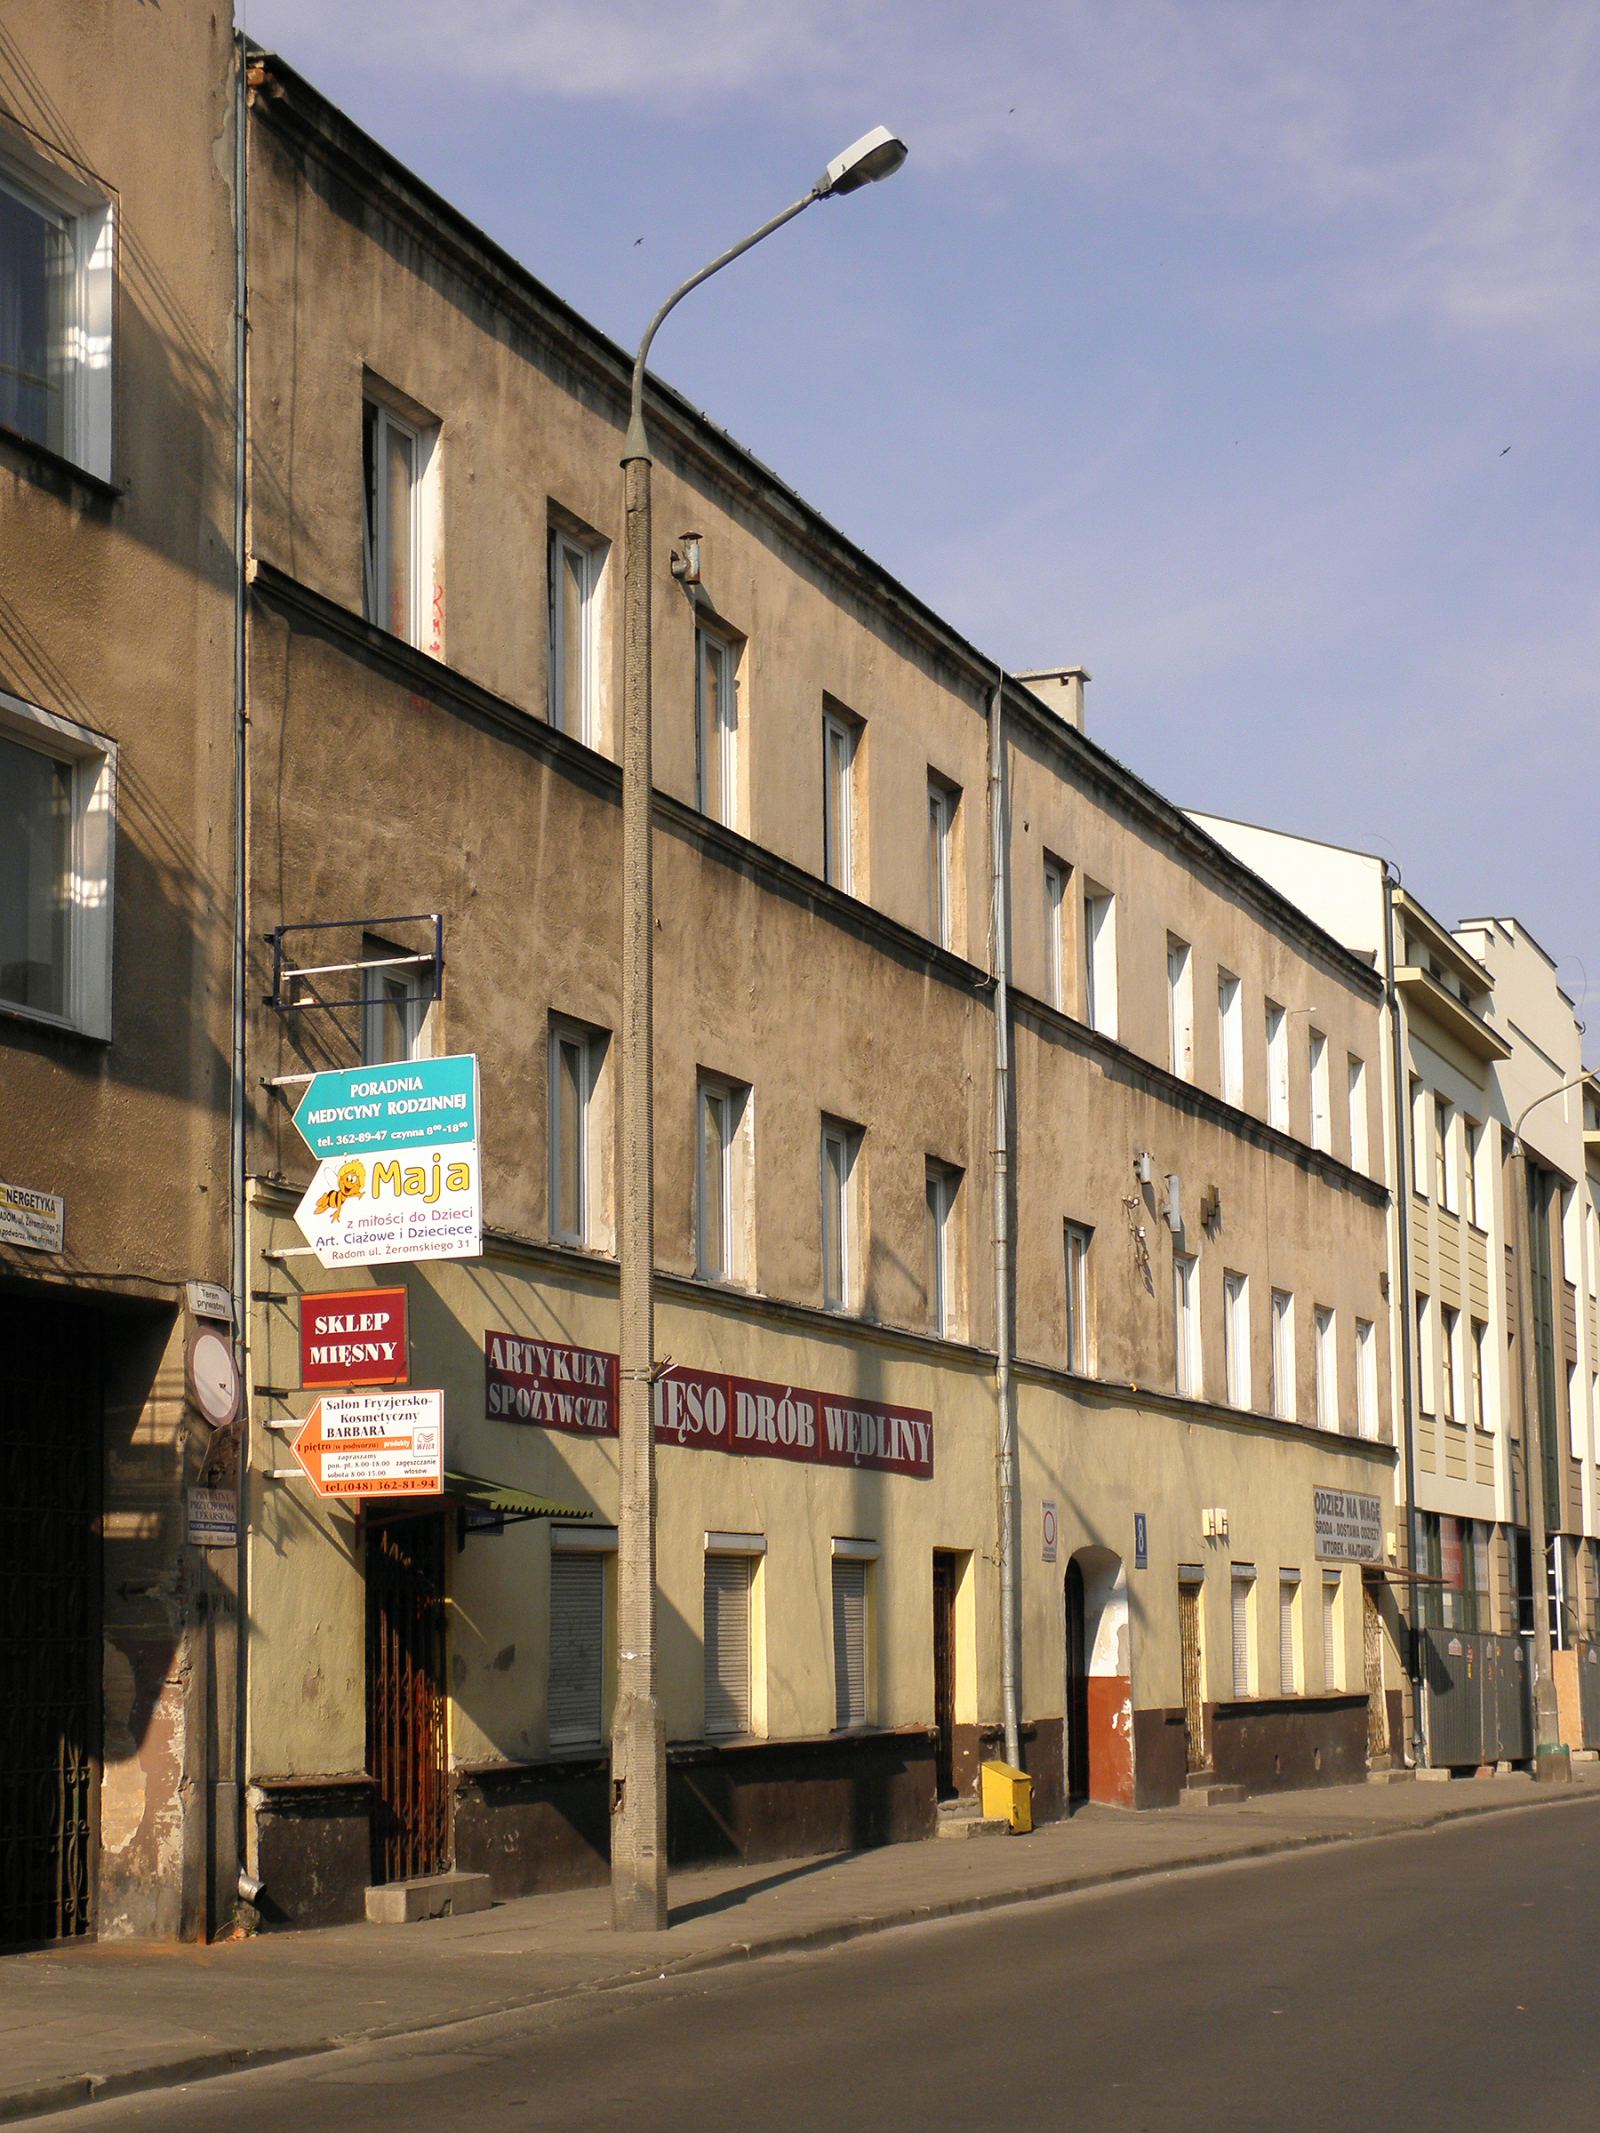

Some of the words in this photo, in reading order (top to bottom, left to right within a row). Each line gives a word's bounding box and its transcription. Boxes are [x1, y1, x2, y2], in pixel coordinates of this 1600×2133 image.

[350, 1076, 423, 1098] PORADNIA
[307, 1103, 381, 1124] MEDYCYNY
[387, 1093, 466, 1115] RODZINNEJ
[317, 1136, 334, 1147] tel.
[336, 1130, 387, 1145] 362-89-47
[391, 1127, 424, 1139] czynna
[371, 1152, 470, 1204] Maja
[347, 1220, 353, 1229] z
[358, 1212, 404, 1229] miłości
[409, 1211, 426, 1223] do
[431, 1206, 473, 1221] Dzieci
[315, 1236, 339, 1247] Art.
[344, 1230, 395, 1245] Ciążowe
[399, 1229, 403, 1239] i
[408, 1224, 473, 1239] Dziecięce
[332, 1251, 366, 1260] Radom
[368, 1247, 381, 1257] ul.
[385, 1241, 453, 1255] Żeromskiego
[457, 1239, 470, 1249] 31
[200, 1288, 220, 1300] Teren
[196, 1300, 226, 1313] prywatny
[314, 1312, 390, 1335] SKLEP
[309, 1341, 398, 1367] MIĘSNY
[489, 1337, 608, 1387] ARTYKUŁY
[326, 1399, 360, 1410] Salon
[364, 1395, 433, 1410] Fryzjersko-
[489, 1379, 608, 1428] SPOŻYWCZE
[340, 1411, 419, 1425] Kosmetyczny
[654, 1378, 727, 1444] IĘSO
[735, 1386, 815, 1448] DRÓB
[824, 1406, 932, 1465] WĘDLINY
[327, 1425, 386, 1438] BARBARA
[303, 1442, 331, 1454] piętro
[383, 1439, 411, 1449] produkty
[395, 1458, 436, 1468] zagęszczanie
[377, 1479, 436, 1490] 362-81-94
[1314, 1489, 1345, 1518] ODZIEŻ
[1346, 1498, 1358, 1520] NA
[1138, 1517, 1144, 1553] 8
